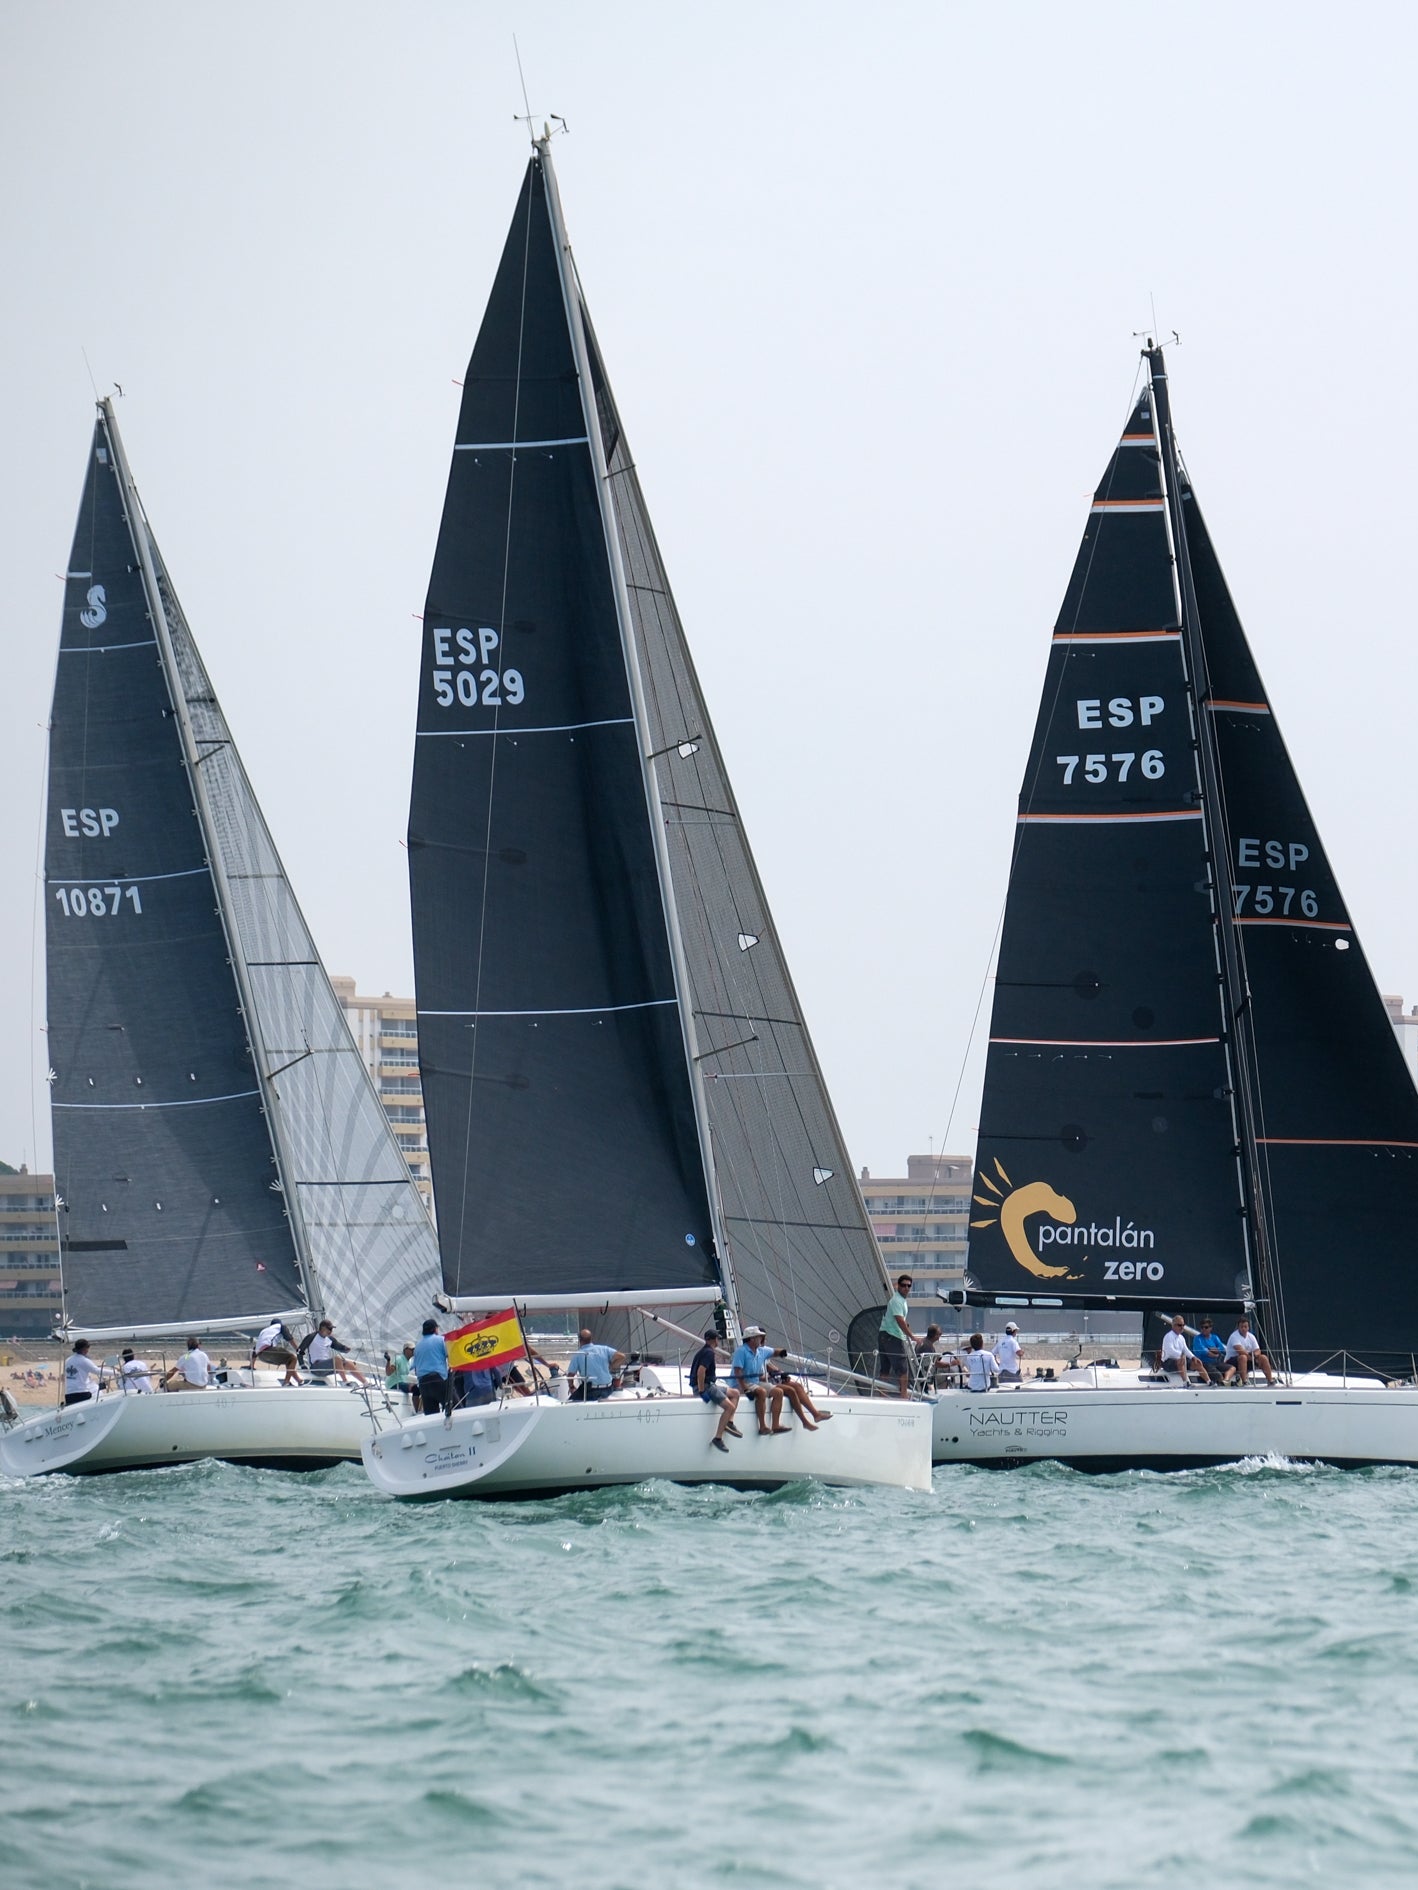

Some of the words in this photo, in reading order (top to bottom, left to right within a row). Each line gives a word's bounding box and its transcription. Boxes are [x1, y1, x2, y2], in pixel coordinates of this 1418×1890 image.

[433, 628, 499, 665] ESP
[433, 669, 525, 706] 5029
[1077, 696, 1165, 729] ESP
[1056, 749, 1165, 785] 7576
[61, 808, 120, 837] ESP
[1239, 838, 1309, 871] ESP
[55, 886, 142, 917] 10871
[1232, 885, 1319, 918] 7576
[1038, 1216, 1154, 1251] pantalán
[1103, 1261, 1165, 1280] zero
[44, 1420, 75, 1438] Mencey
[637, 1409, 661, 1424] 40.7
[969, 1411, 1068, 1425] NAUTTER
[970, 1429, 1010, 1437] Yachts
[1014, 1428, 1022, 1436] &
[1026, 1428, 1067, 1437] Rigging
